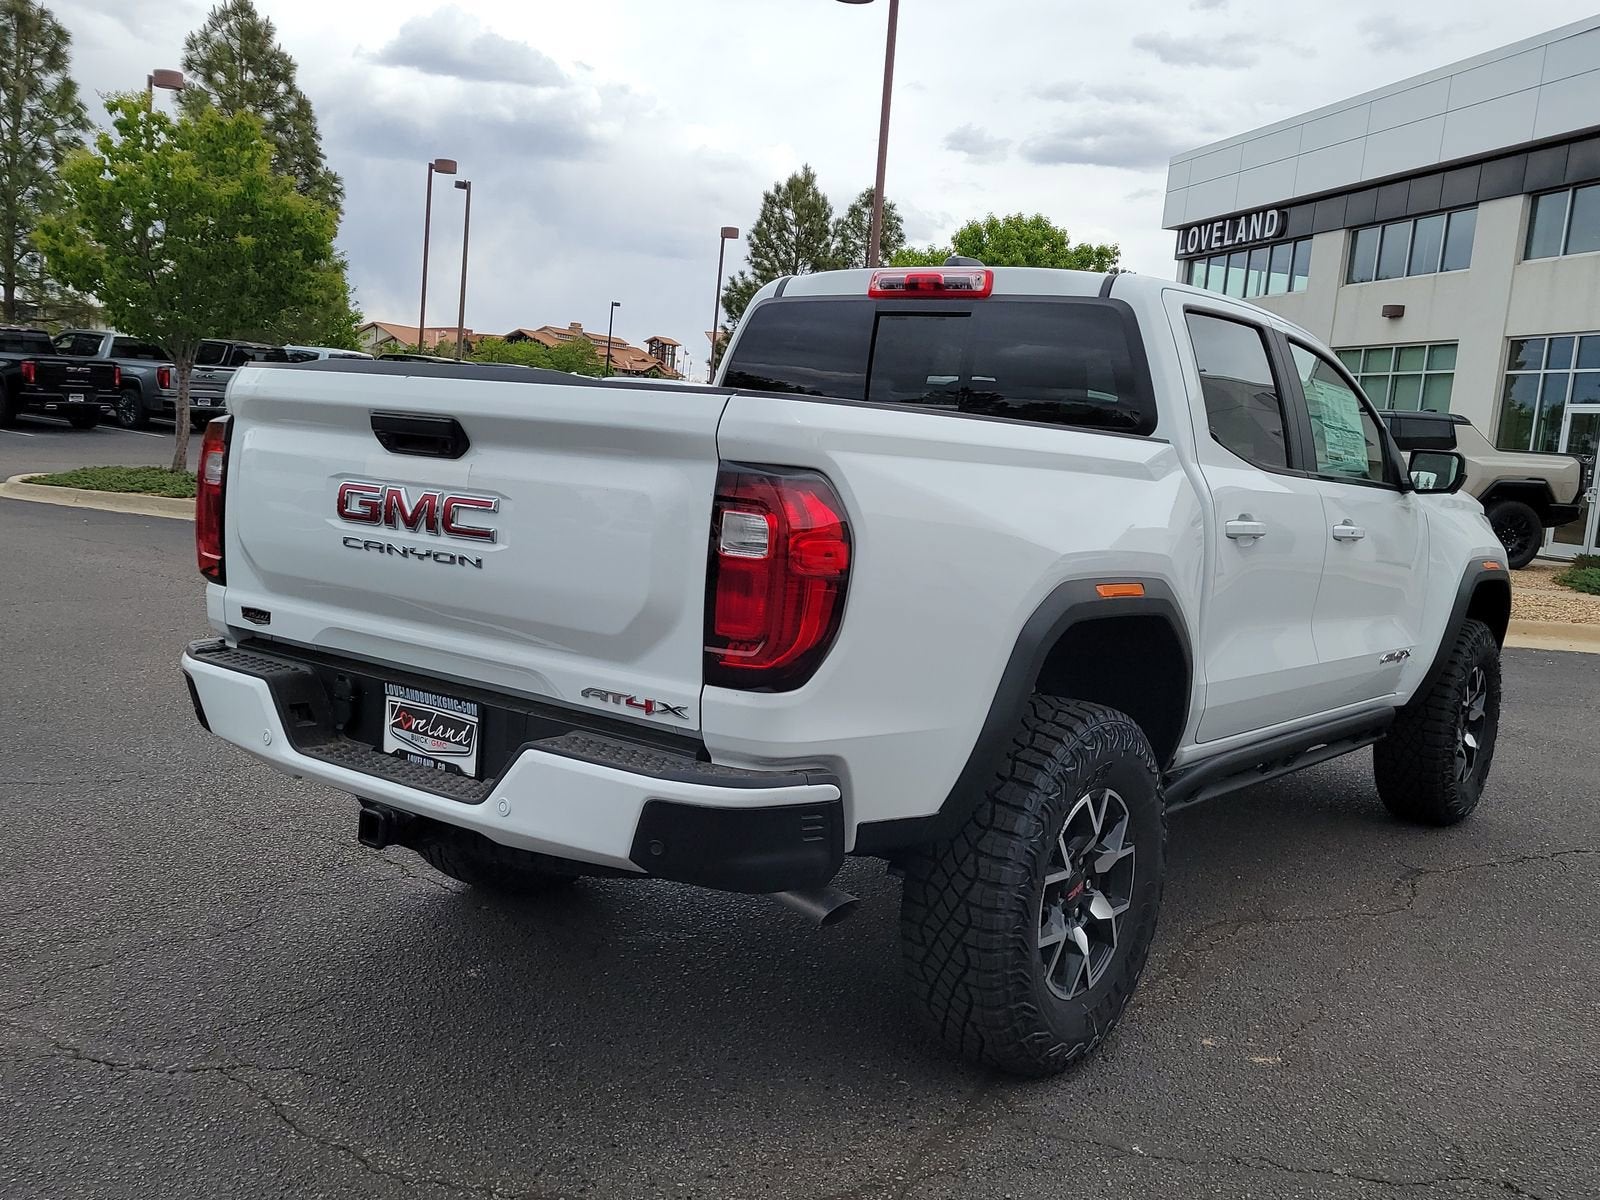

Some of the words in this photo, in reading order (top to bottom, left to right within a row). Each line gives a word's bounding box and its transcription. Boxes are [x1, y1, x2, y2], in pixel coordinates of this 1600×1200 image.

[1177, 209, 1279, 254] LOVELAND
[337, 482, 499, 544] GMC
[342, 535, 483, 569] CANYON
[581, 687, 689, 720] AT4X
[410, 733, 428, 745] BUICK
[431, 739, 448, 749] GMC
